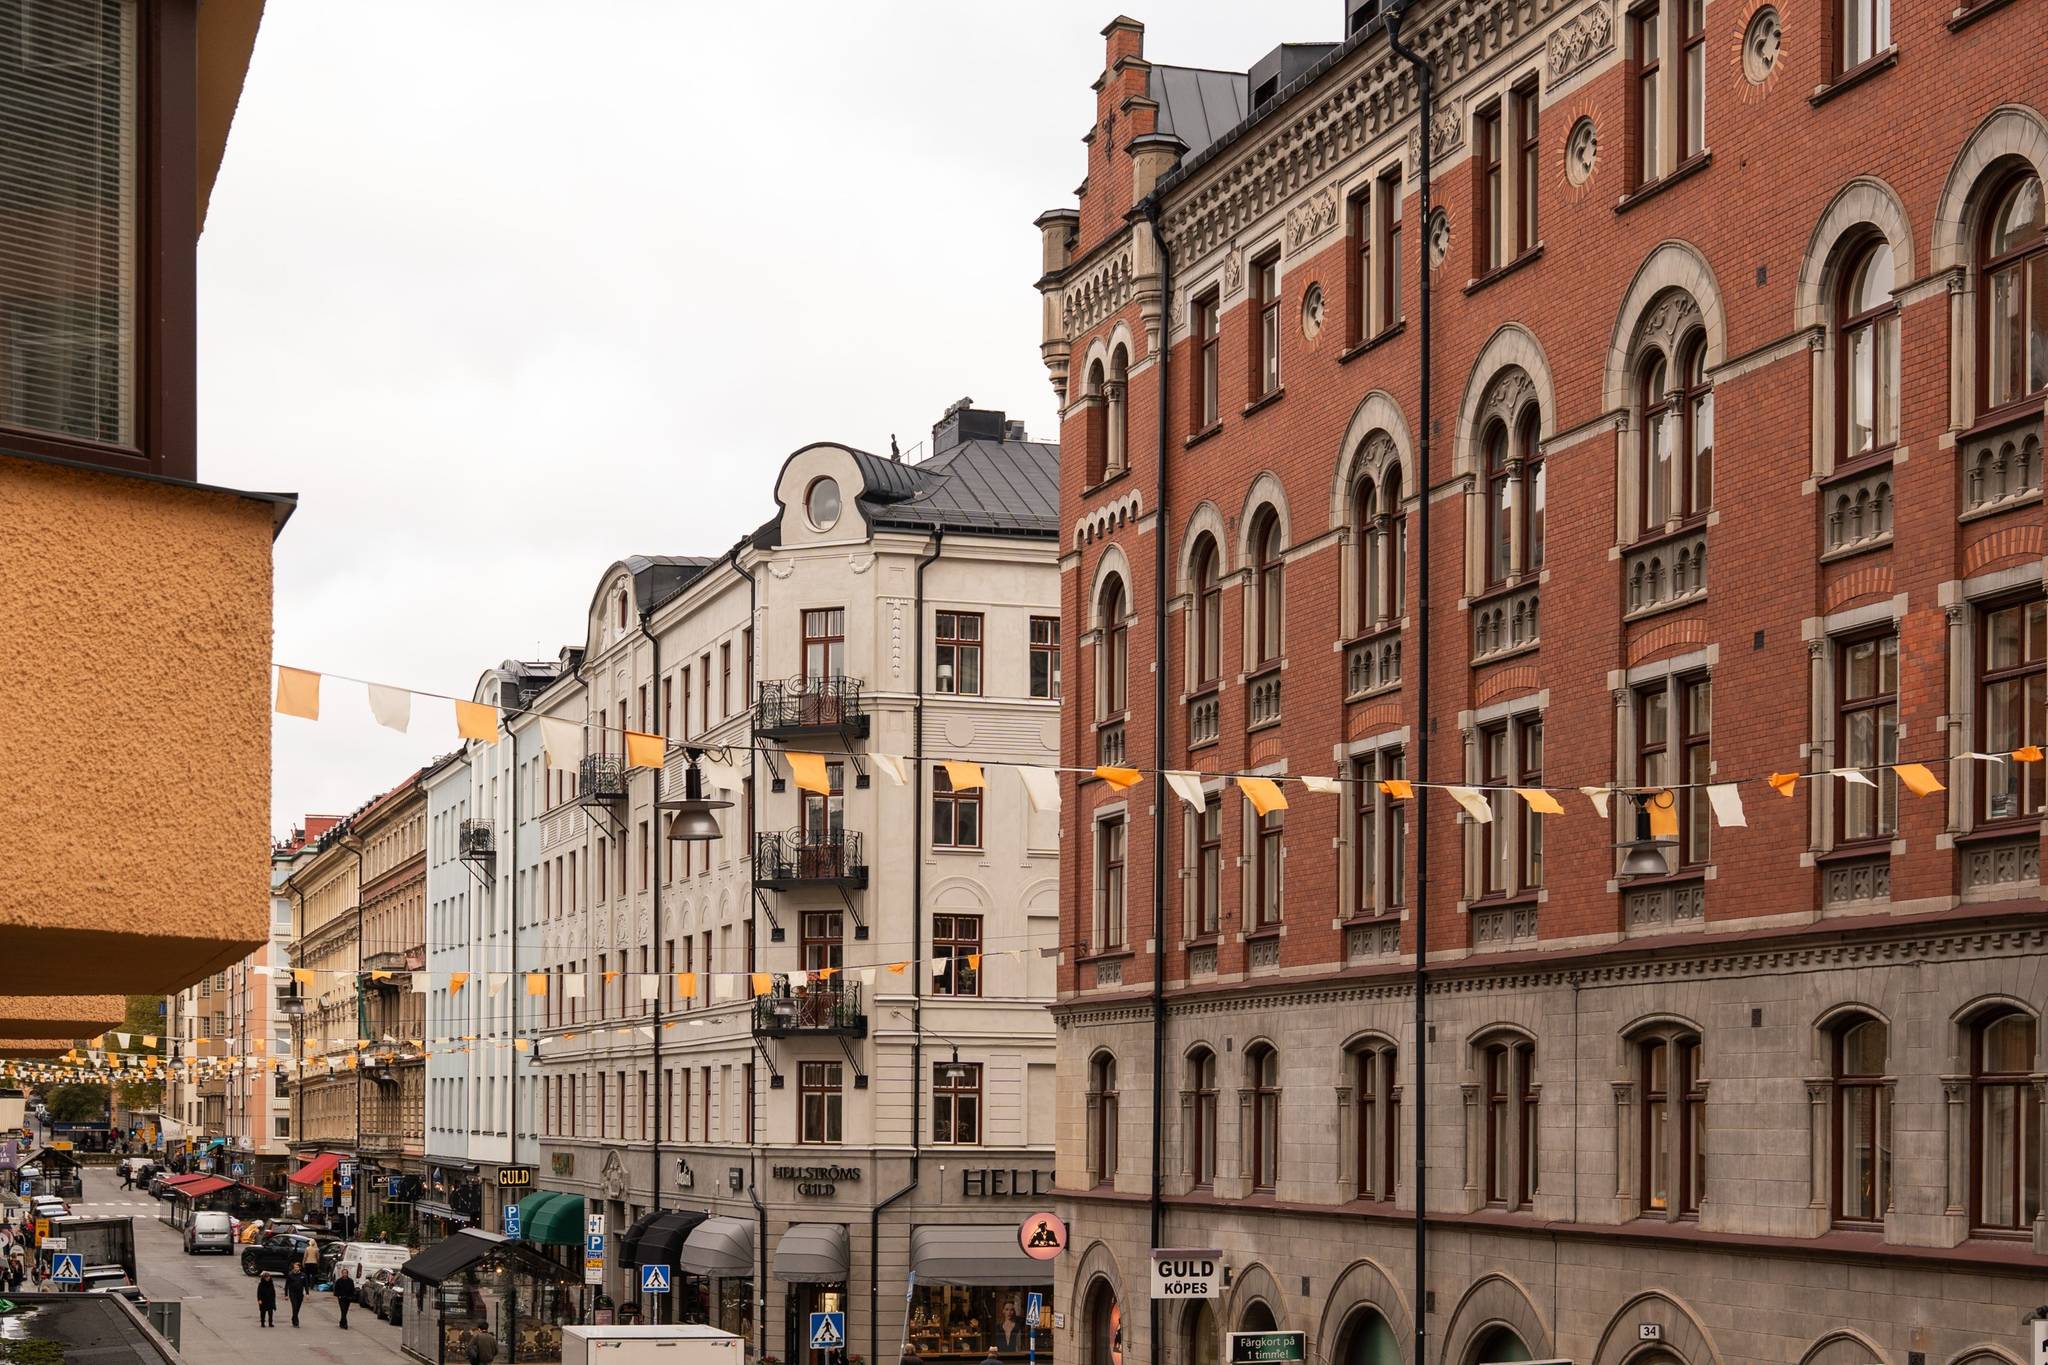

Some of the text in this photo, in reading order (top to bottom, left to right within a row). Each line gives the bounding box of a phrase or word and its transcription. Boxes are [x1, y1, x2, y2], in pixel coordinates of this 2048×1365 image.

[500, 1169, 530, 1185] GULD
[772, 1164, 861, 1180] HELLSTRÖMS
[23, 1182, 30, 1191] P
[797, 1182, 836, 1196] GULD
[508, 1206, 517, 1218] P
[591, 1236, 601, 1249] P
[1158, 1260, 1214, 1277] GULD
[1164, 1280, 1208, 1294] KÖPES
[1643, 1326, 1656, 1337] 34
[1241, 1336, 1295, 1349] Färgkort på
[1247, 1349, 1289, 1360] 1 timme!
